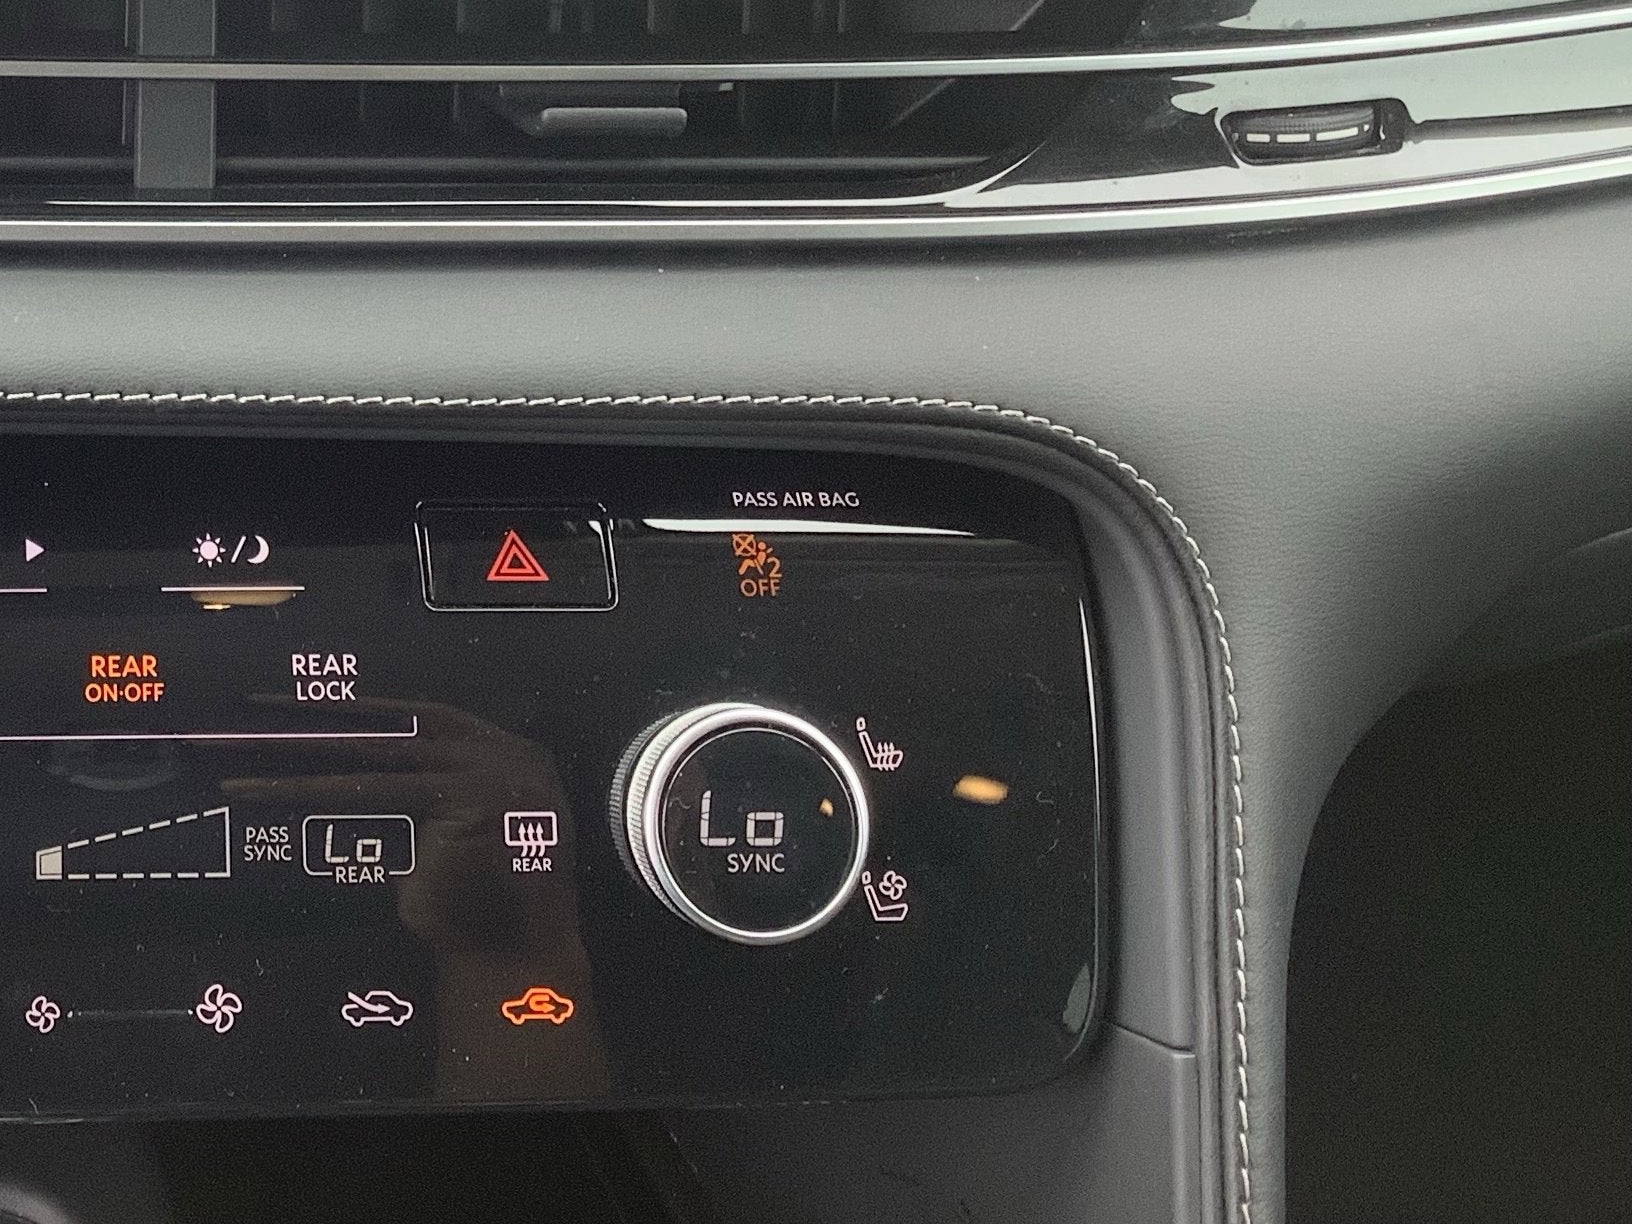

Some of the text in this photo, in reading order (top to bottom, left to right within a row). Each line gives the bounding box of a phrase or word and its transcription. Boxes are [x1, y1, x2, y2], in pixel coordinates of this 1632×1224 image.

[732, 491, 860, 508] PASS AIR BAG
[740, 578, 781, 597] OFF
[91, 654, 159, 678] REAR
[291, 654, 358, 676] REAR
[296, 679, 356, 702] LOCK
[245, 826, 290, 844] PASS
[243, 844, 293, 862] SYNC
[512, 857, 553, 873] REAR
[727, 853, 786, 874] SYNC
[335, 866, 386, 884] REAR
